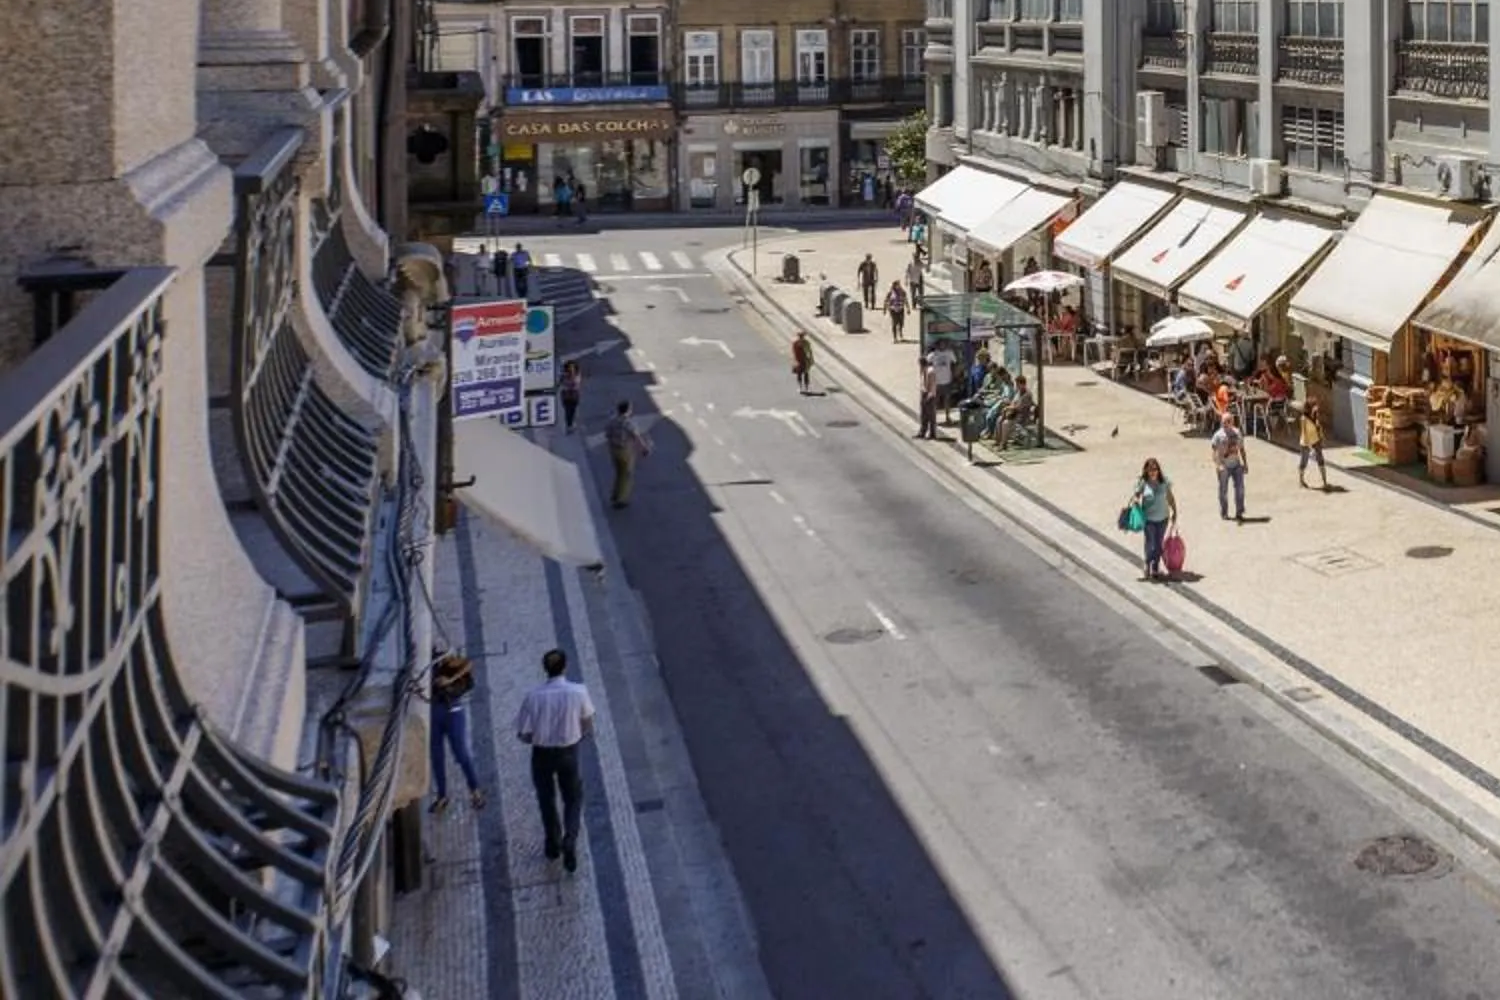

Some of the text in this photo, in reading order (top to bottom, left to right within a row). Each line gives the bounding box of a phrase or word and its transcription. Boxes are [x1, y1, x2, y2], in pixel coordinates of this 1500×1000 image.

[506, 119, 670, 136] CASA DAS COLCHAS
